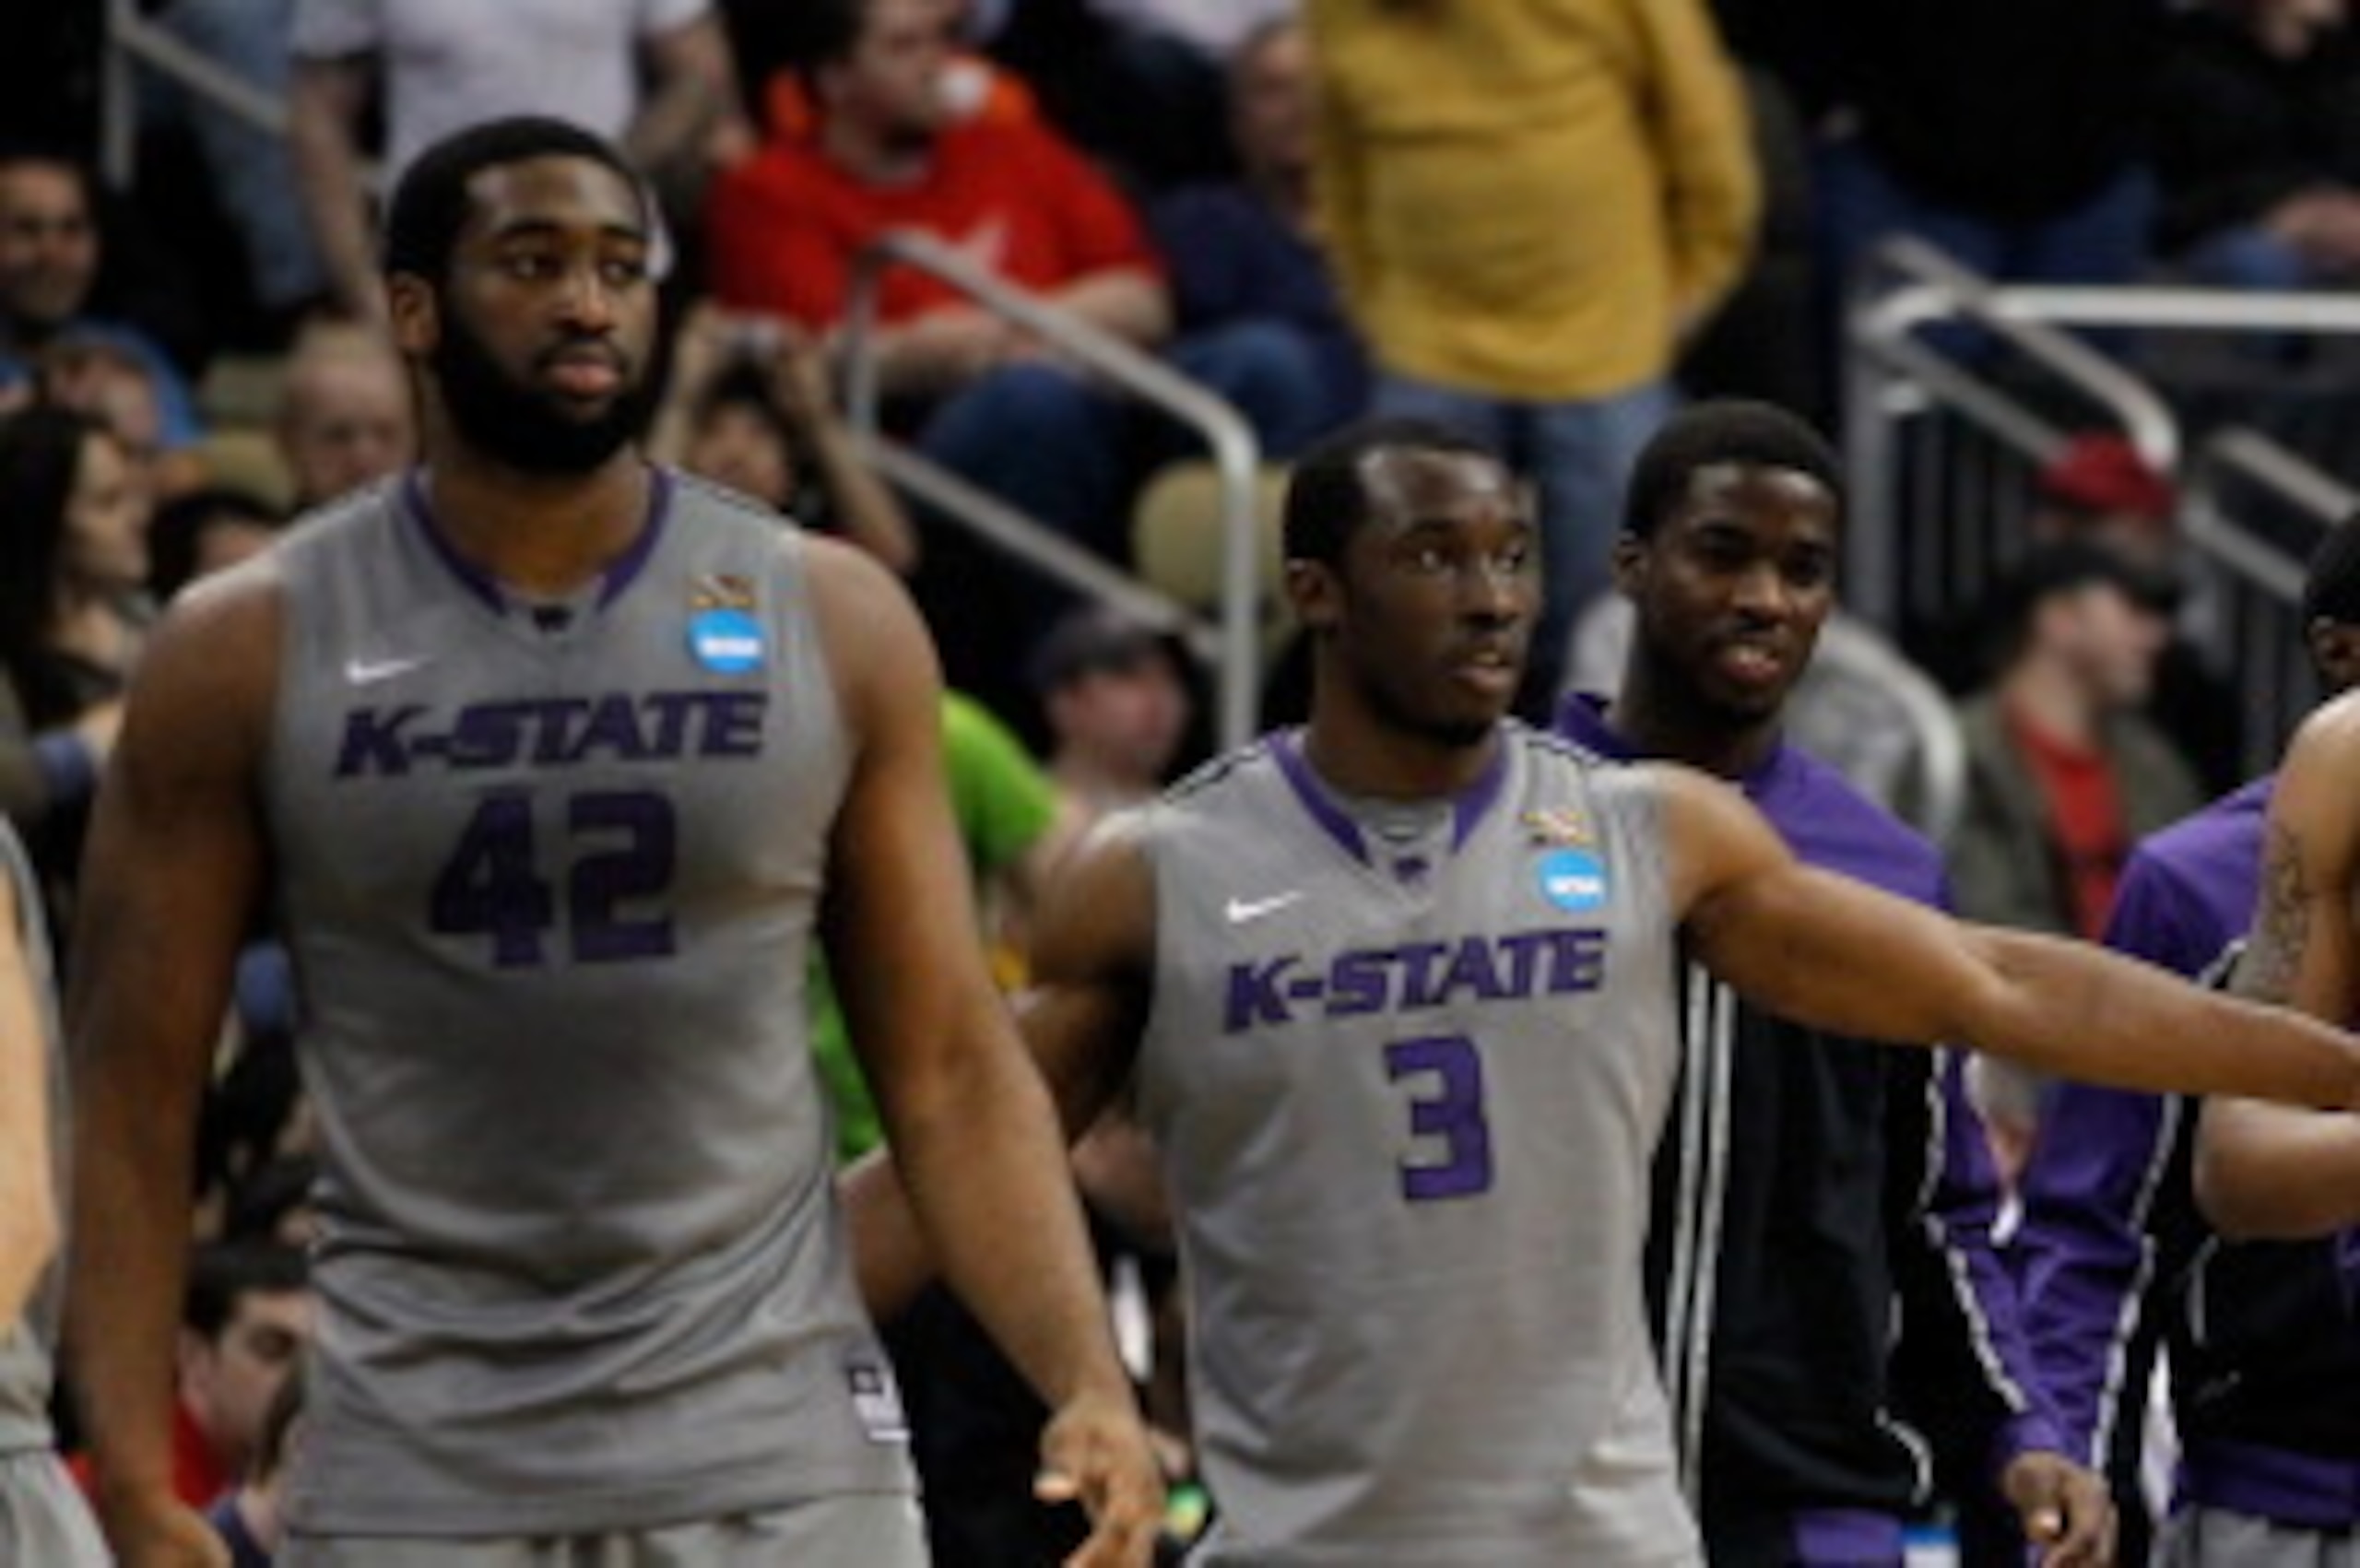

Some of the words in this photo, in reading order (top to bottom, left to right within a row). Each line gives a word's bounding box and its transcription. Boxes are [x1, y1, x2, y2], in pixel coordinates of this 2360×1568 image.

[334, 691, 768, 776] K-STATE
[431, 789, 678, 967] 42
[1223, 929, 1607, 1033] K-STATE
[1384, 1035, 1493, 1200] 3
